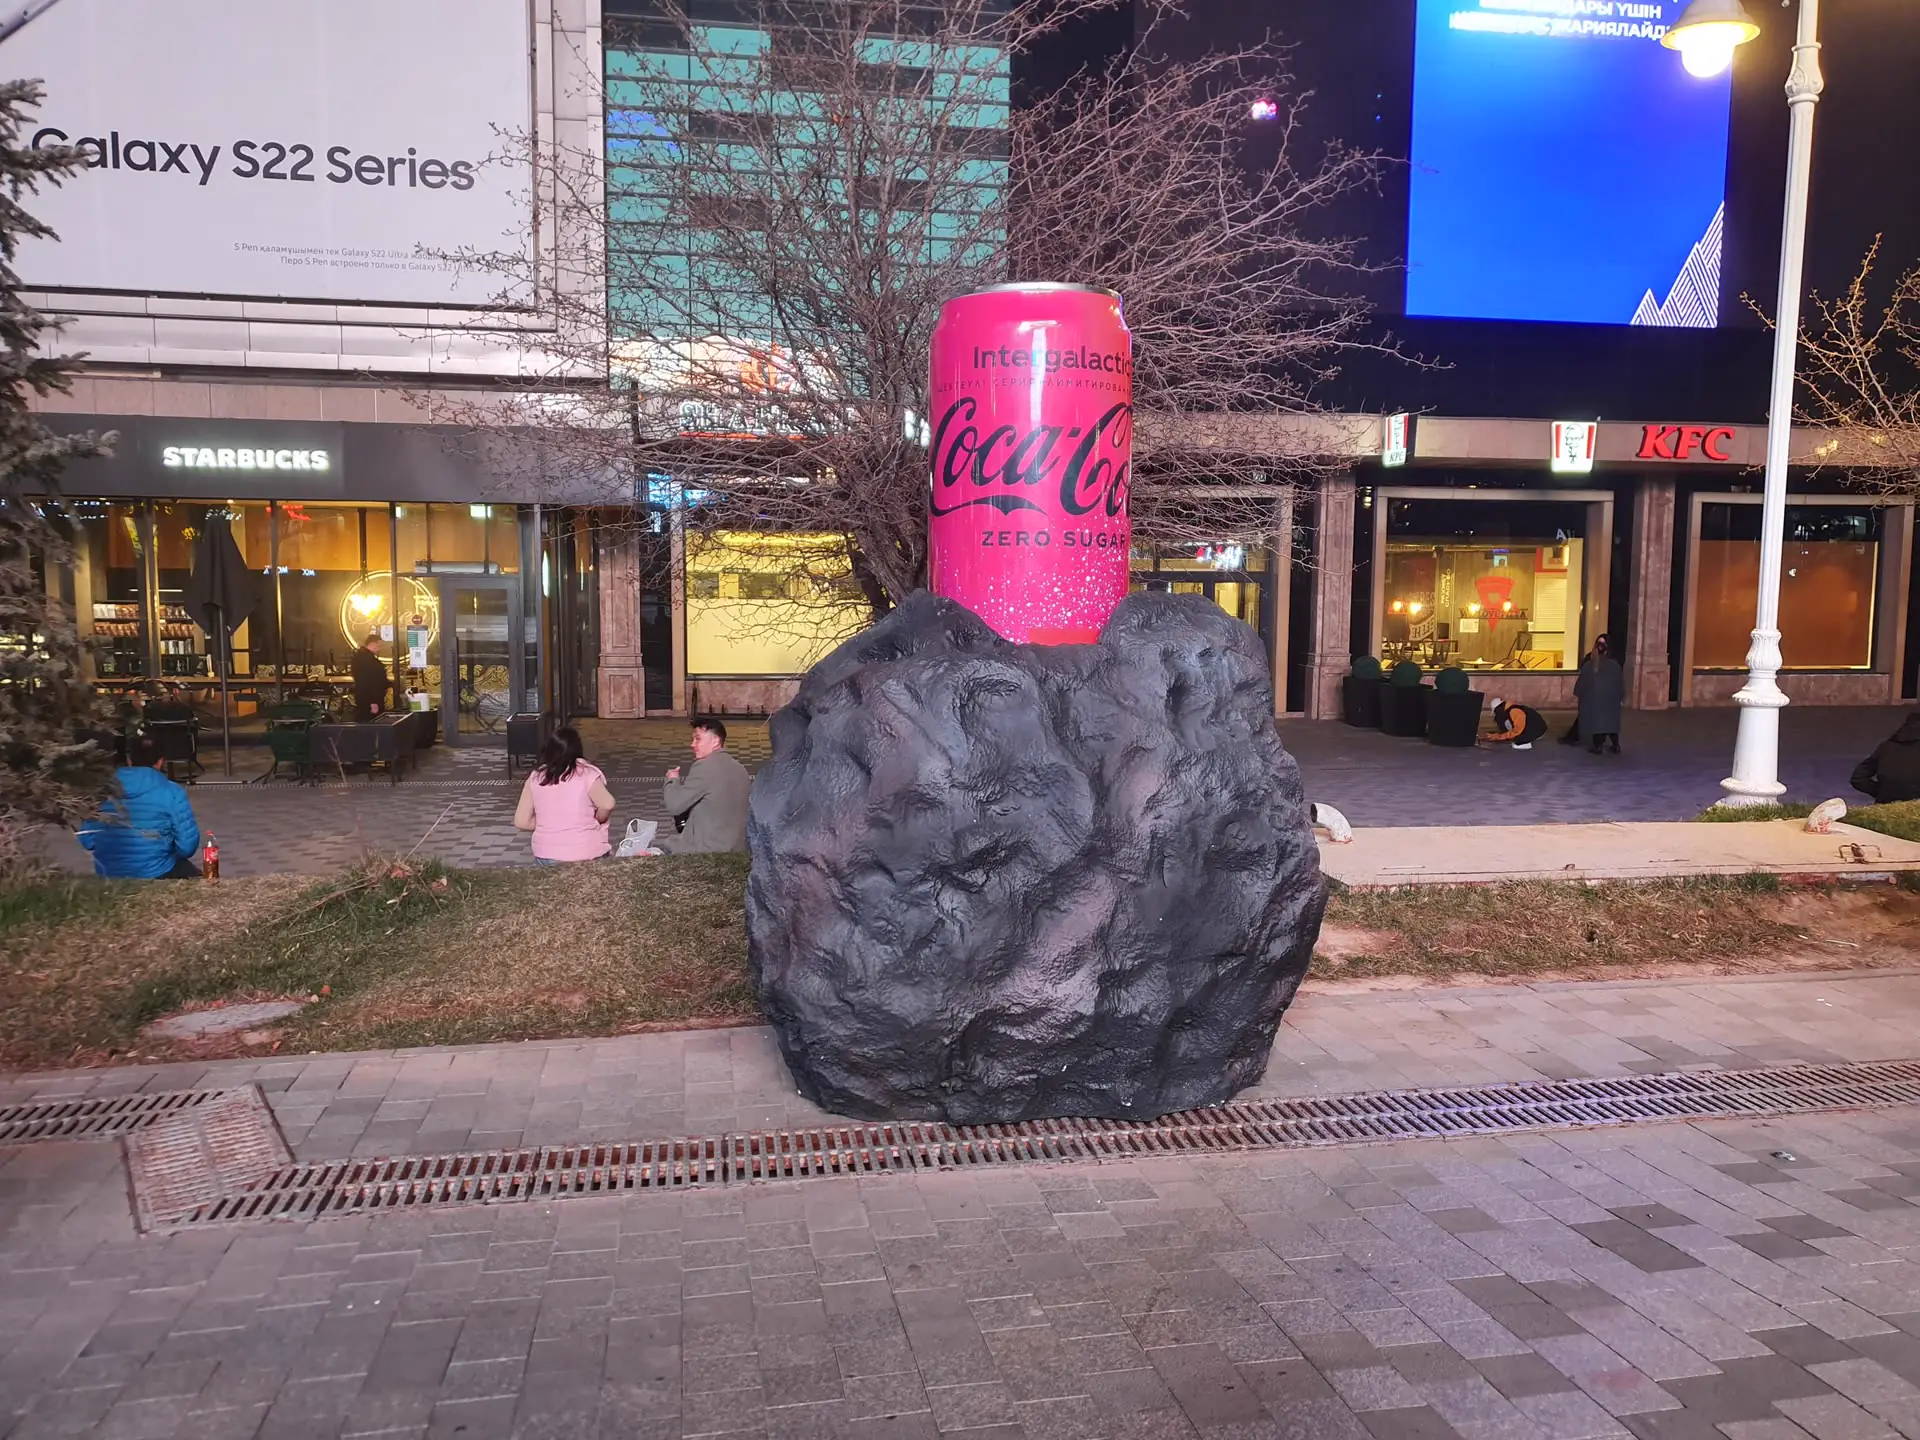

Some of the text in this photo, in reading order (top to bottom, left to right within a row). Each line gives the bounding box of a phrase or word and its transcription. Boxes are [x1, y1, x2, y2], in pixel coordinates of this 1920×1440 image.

[1616, 2, 1662, 19] ҮШІН
[1551, 18, 1671, 41] ЖАРИЯЛАЙД
[232, 139, 315, 182] S22
[326, 146, 475, 190] Series
[234, 242, 240, 251] S
[242, 243, 258, 252] Pen
[341, 248, 369, 259] Galaxy
[371, 250, 386, 258] S22
[281, 256, 303, 266] Перо
[305, 257, 311, 265] S
[312, 257, 328, 266] Pen
[330, 260, 369, 268] встроено
[371, 262, 400, 270] только
[408, 263, 436, 273] Galaxy
[1636, 425, 1735, 461] KFC
[163, 446, 329, 471] STARBUCKS
[982, 530, 1126, 549] ZERO SUGAR
